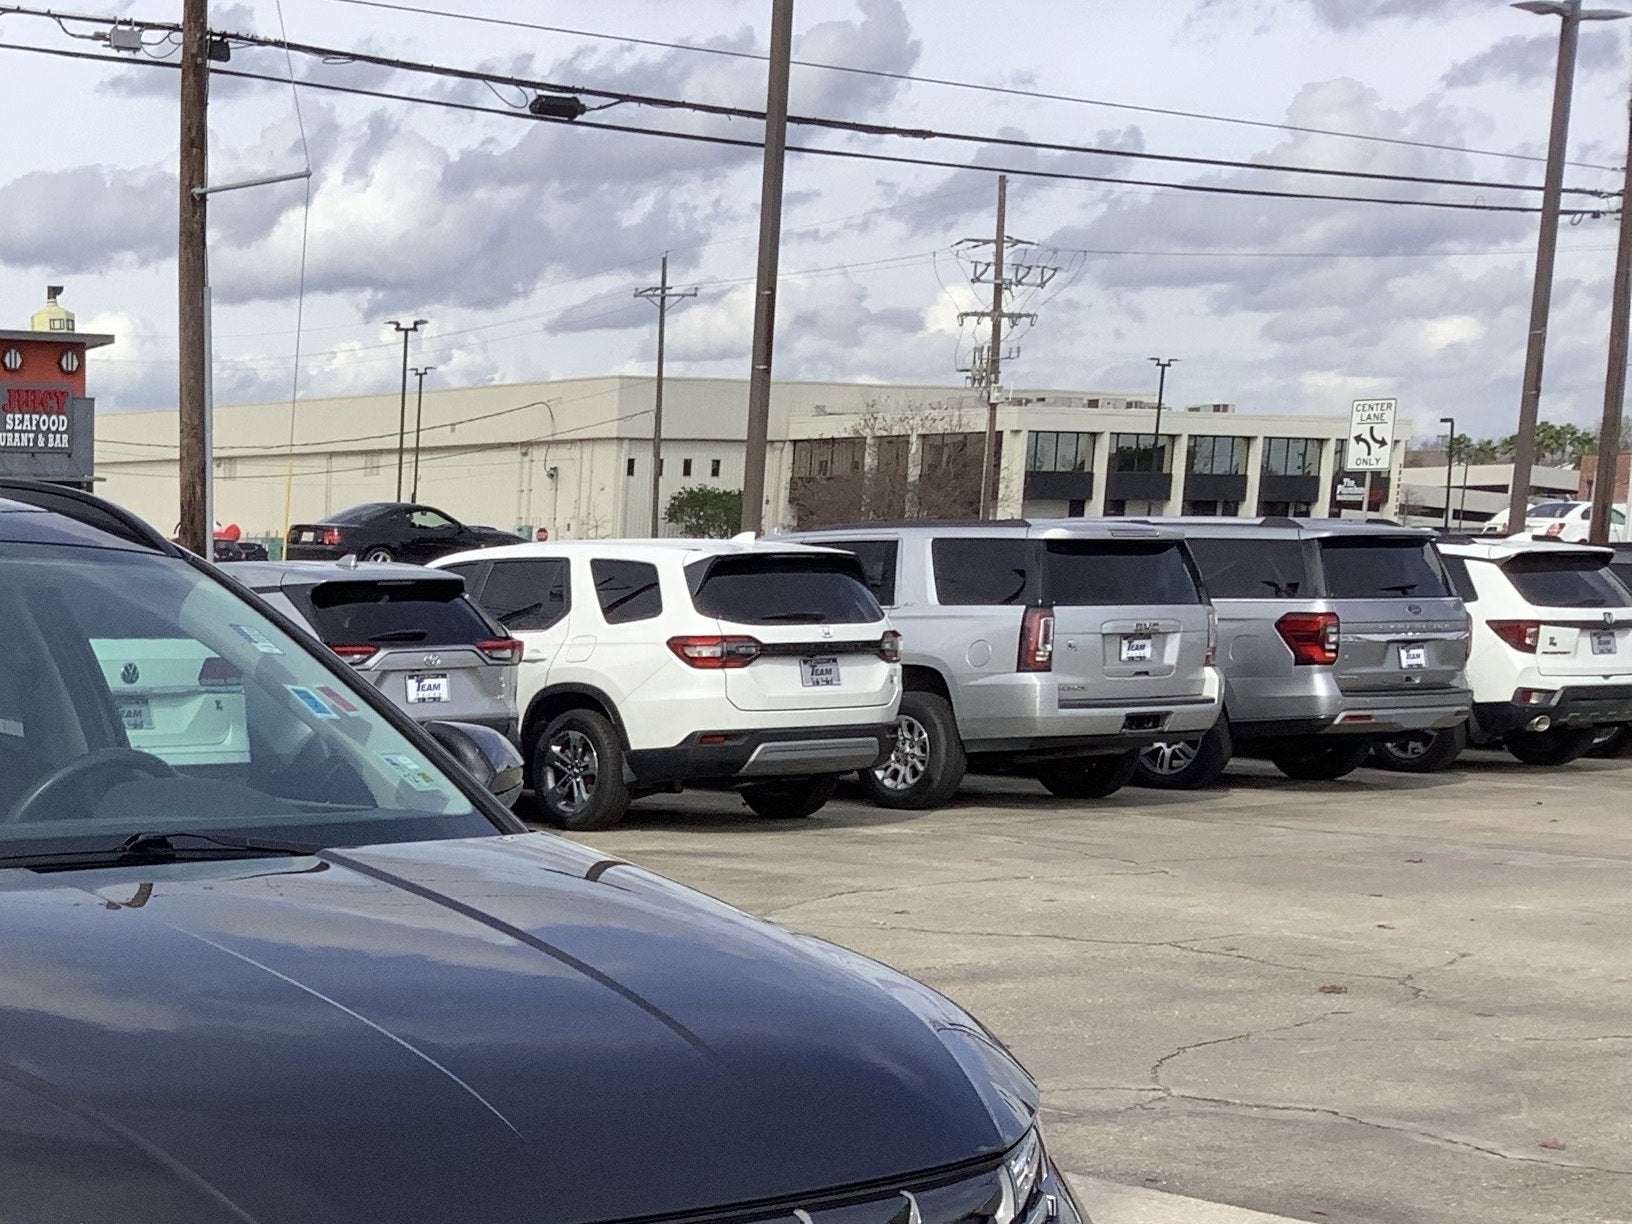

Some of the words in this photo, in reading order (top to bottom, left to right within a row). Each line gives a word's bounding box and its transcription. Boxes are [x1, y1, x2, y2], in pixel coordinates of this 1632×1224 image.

[2, 389, 70, 414] JUICY
[1355, 402, 1393, 413] CENTER
[5, 413, 68, 431] SEAFOOD
[1360, 413, 1386, 422] LANE
[37, 433, 46, 447] &
[47, 433, 69, 448] BAR
[1355, 457, 1381, 466] ONLY
[809, 665, 833, 677] TEAM
[415, 676, 441, 692] TEAM
